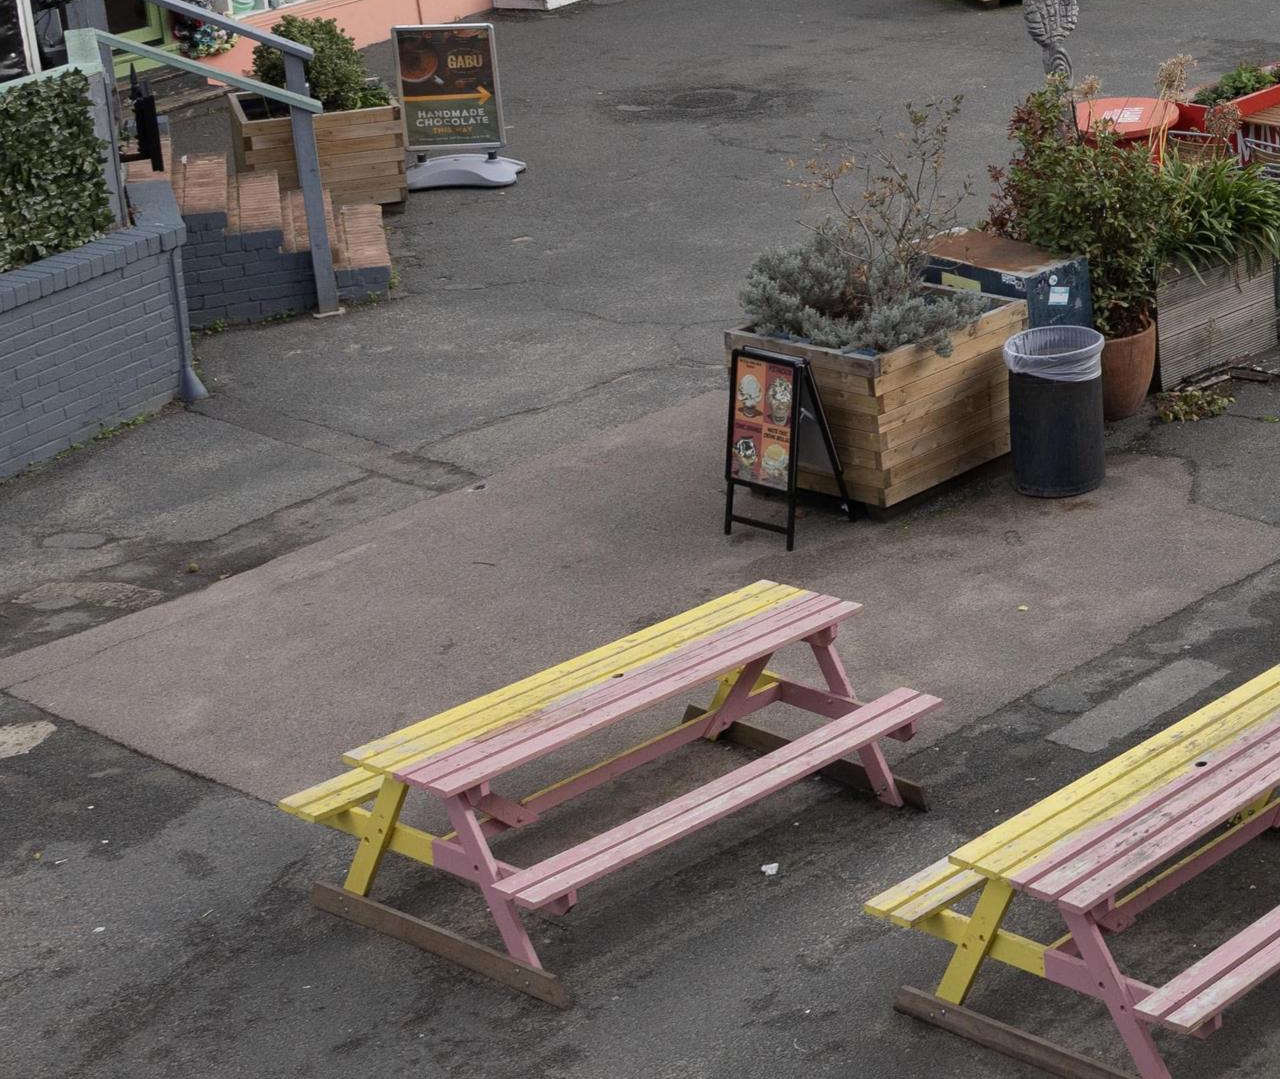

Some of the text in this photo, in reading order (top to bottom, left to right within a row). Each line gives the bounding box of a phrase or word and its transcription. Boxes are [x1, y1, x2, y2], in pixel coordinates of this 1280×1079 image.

[447, 54, 483, 69] GABU
[417, 107, 485, 118] HANDMADE
[415, 116, 489, 127] CHOCOLATE
